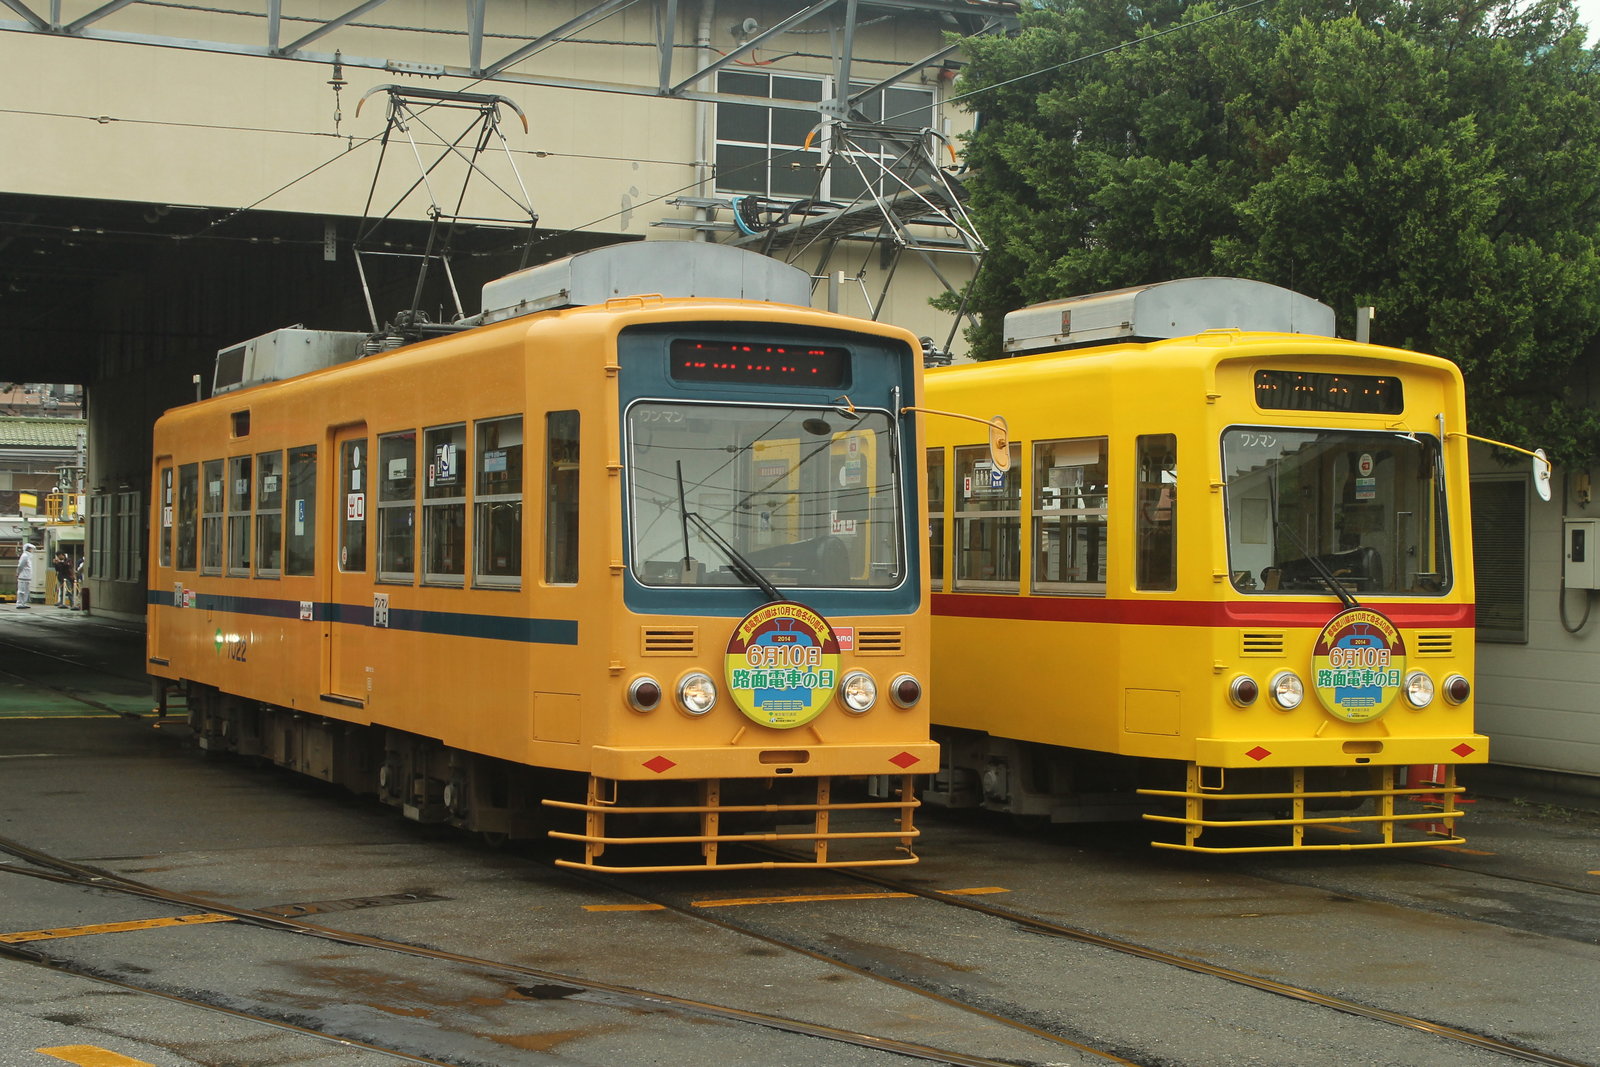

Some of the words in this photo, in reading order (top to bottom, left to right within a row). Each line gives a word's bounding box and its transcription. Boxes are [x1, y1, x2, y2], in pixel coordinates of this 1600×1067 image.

[640, 410, 684, 423] ワンマン
[1240, 433, 1277, 448] ワンマン
[746, 645, 822, 666] 6月10日
[1329, 647, 1391, 667] 6月10日
[732, 669, 834, 689] 路面電車の日
[1317, 669, 1400, 687] 路面電車の日
